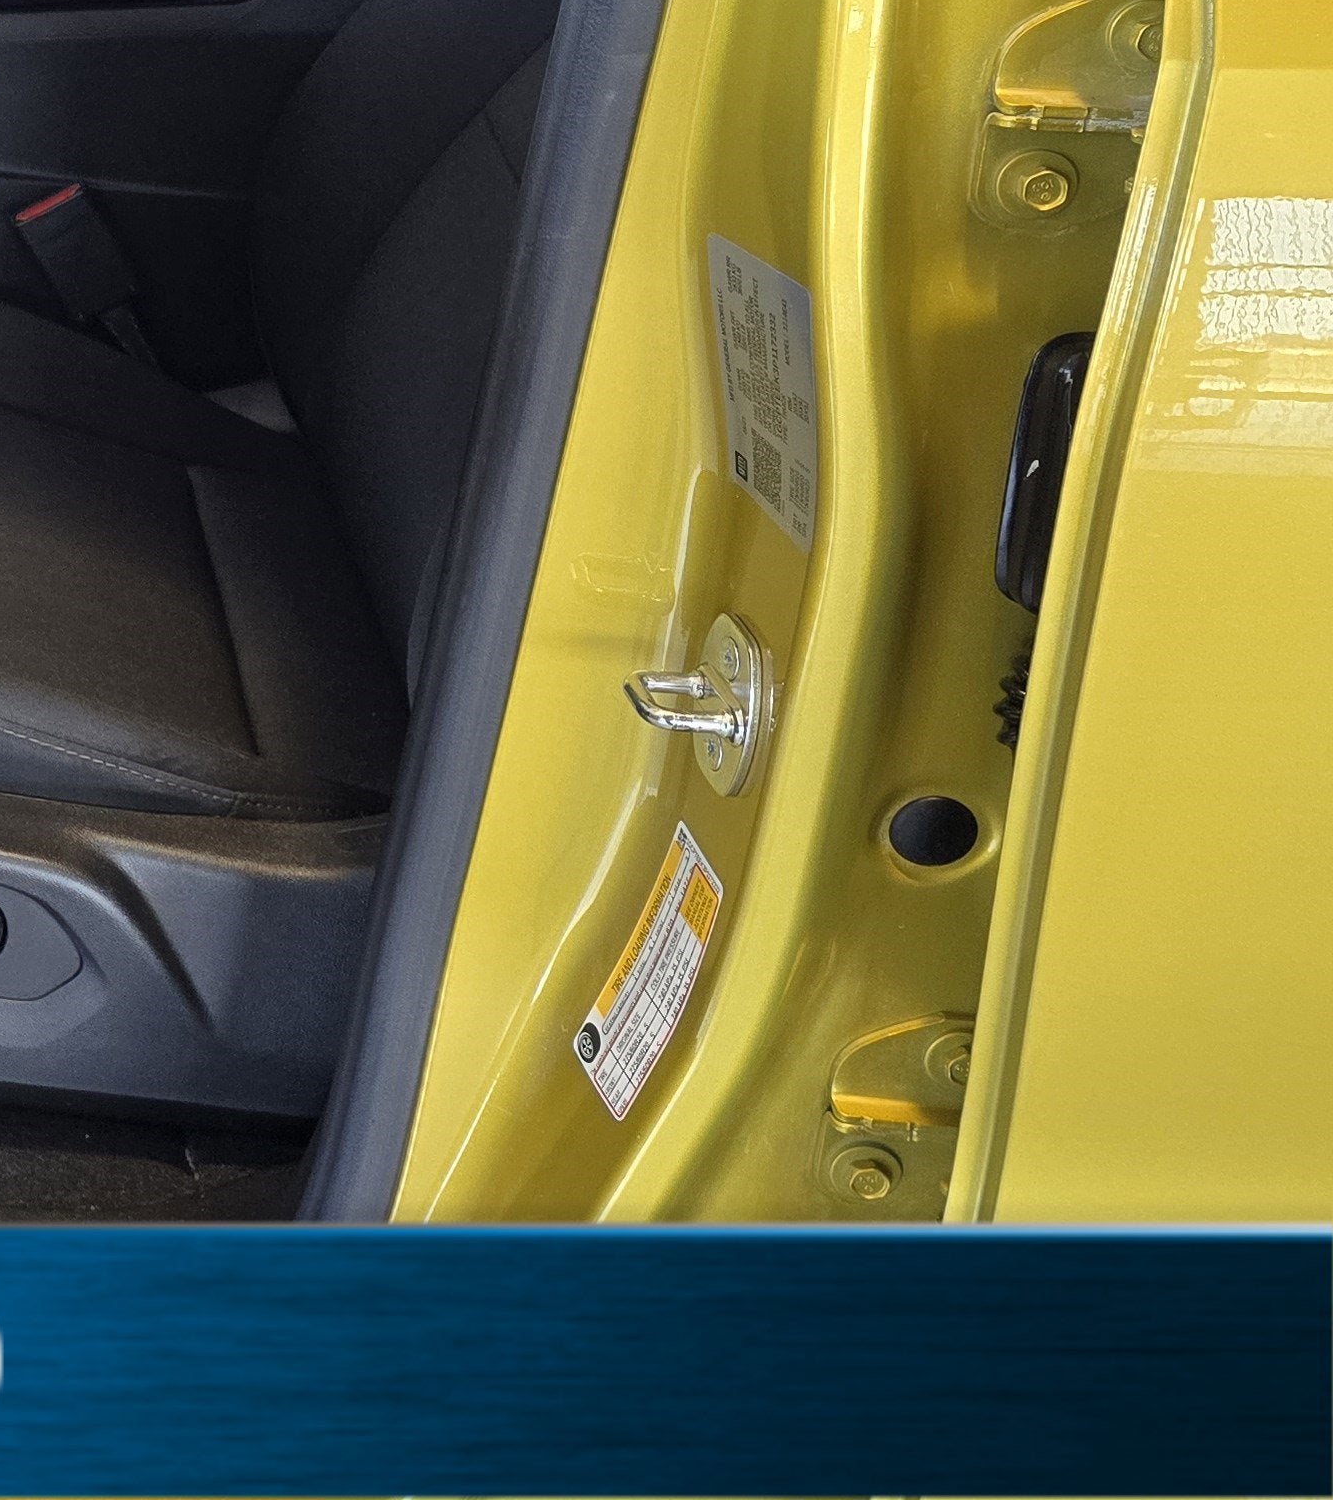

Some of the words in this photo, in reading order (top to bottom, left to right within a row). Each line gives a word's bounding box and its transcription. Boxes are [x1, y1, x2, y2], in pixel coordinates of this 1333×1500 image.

[718, 304, 726, 336] MOTORS
[722, 337, 731, 372] GENERAL
[611, 974, 624, 994] TIRE
[621, 957, 632, 978] AND
[630, 924, 649, 961] LOADING
[645, 872, 671, 928] INFORMATION
[650, 972, 660, 990] COLD
[665, 929, 679, 959] PRESSURE
[616, 1026, 632, 1052] ORIGINAL
[632, 1013, 640, 1025] SIZE
[598, 1070, 607, 1081] TIRE
